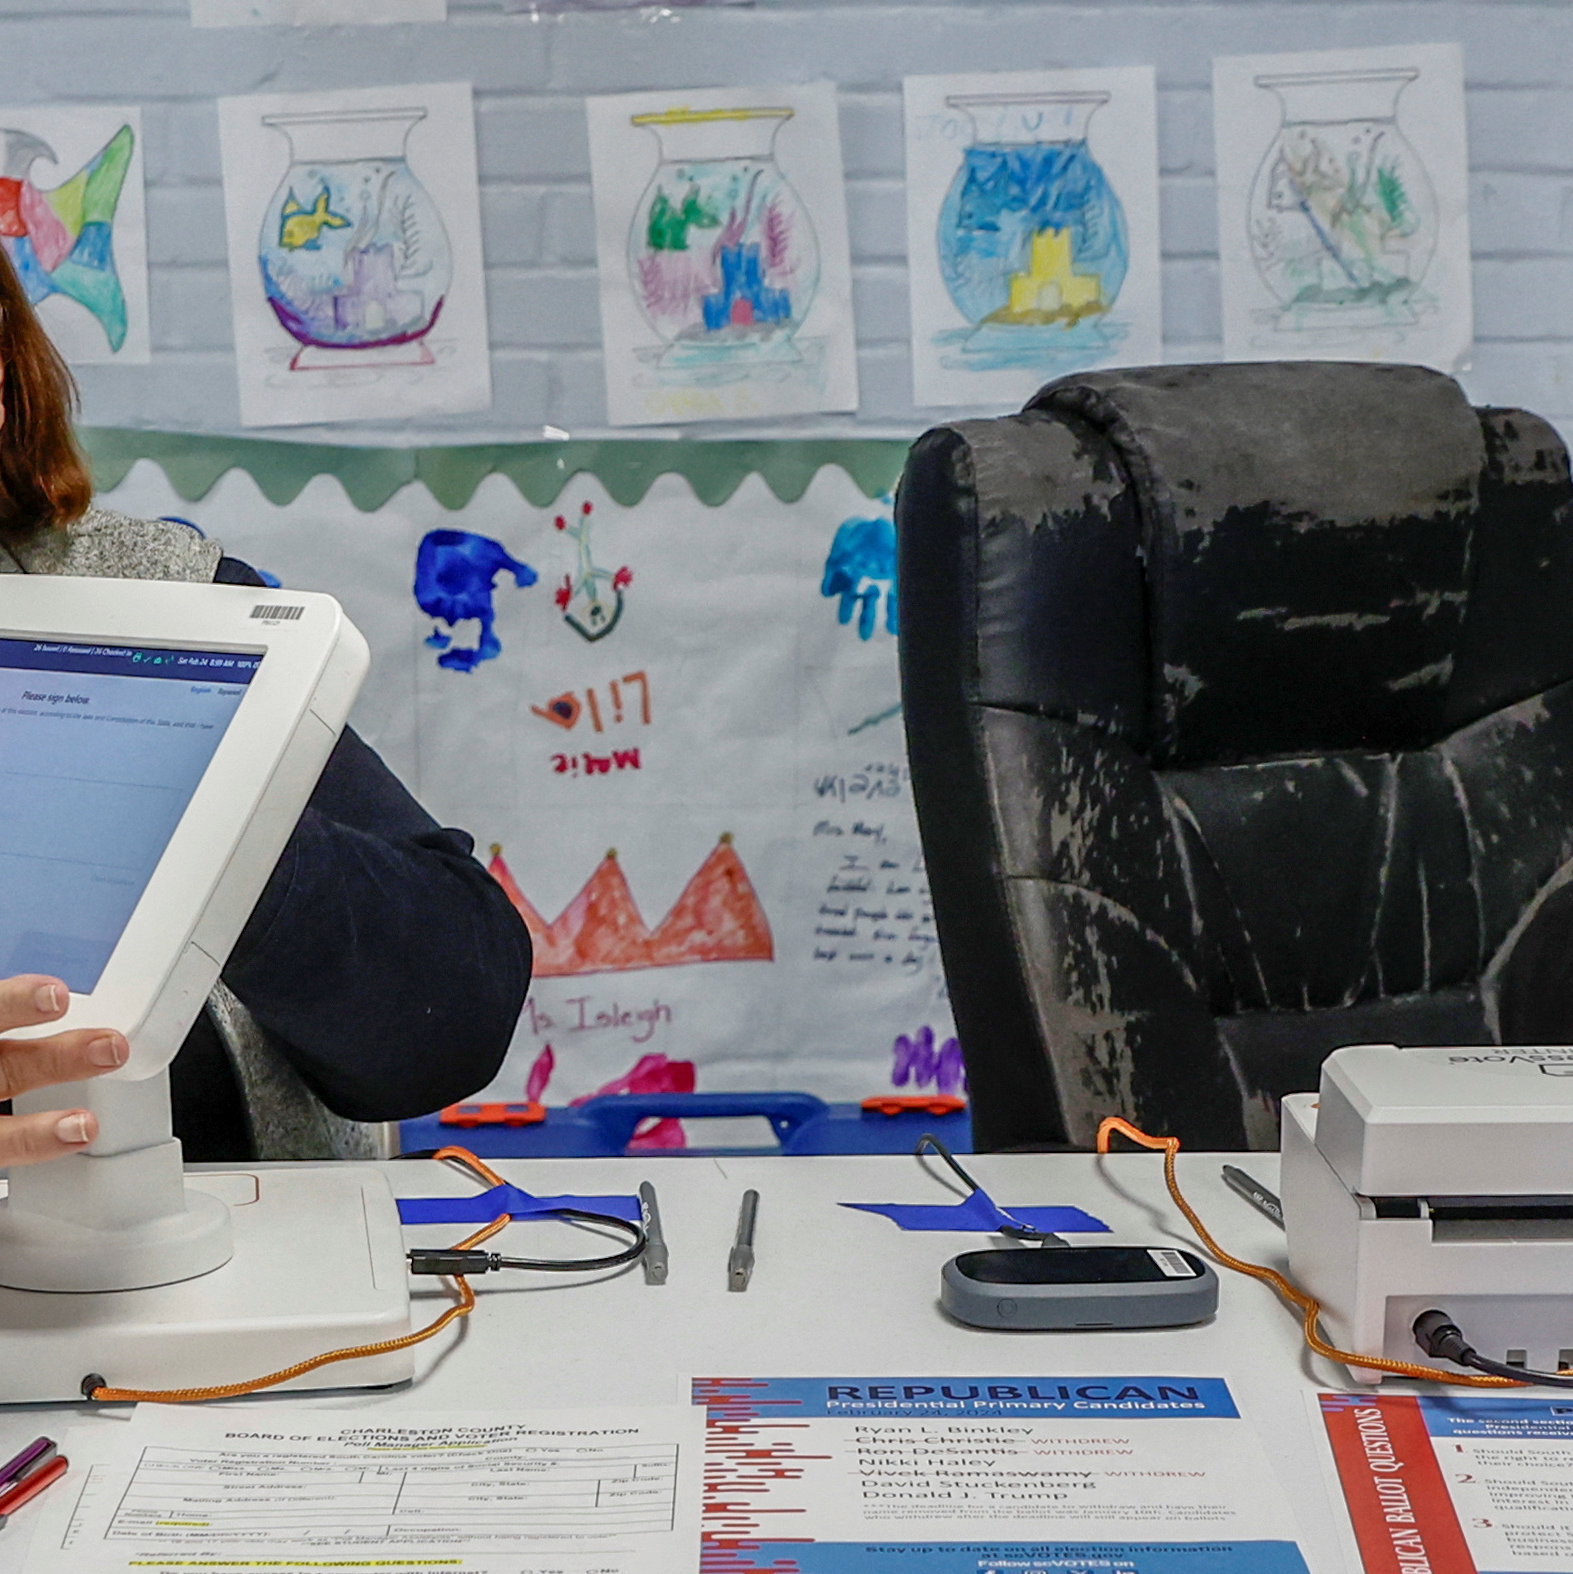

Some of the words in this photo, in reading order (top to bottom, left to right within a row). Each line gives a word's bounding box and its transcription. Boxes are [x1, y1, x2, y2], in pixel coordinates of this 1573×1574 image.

[20, 690, 45, 701] Please
[46, 694, 62, 705] sign
[63, 694, 90, 704] below
[530, 672, 651, 731] Lila
[827, 1385, 1200, 1400] REPUBLICAN
[827, 1401, 966, 1409] Presidential
[973, 1401, 1066, 1410] Primary
[1073, 1401, 1206, 1410] Candidates
[457, 1424, 526, 1432] COUNTY
[515, 1428, 640, 1436] REGISTRATION
[855, 1426, 911, 1434] Ryan
[921, 1426, 939, 1434] L.
[948, 1426, 1034, 1435] Binkley
[439, 1438, 518, 1446] Application
[1355, 1408, 1405, 1472] QUESTIONS
[928, 1459, 996, 1467] Haley
[935, 1470, 1093, 1478] Ramaswamy
[939, 1481, 1097, 1489] Stuckenberg
[987, 1492, 1068, 1500] Trump
[1373, 1476, 1416, 1523] BALLOT
